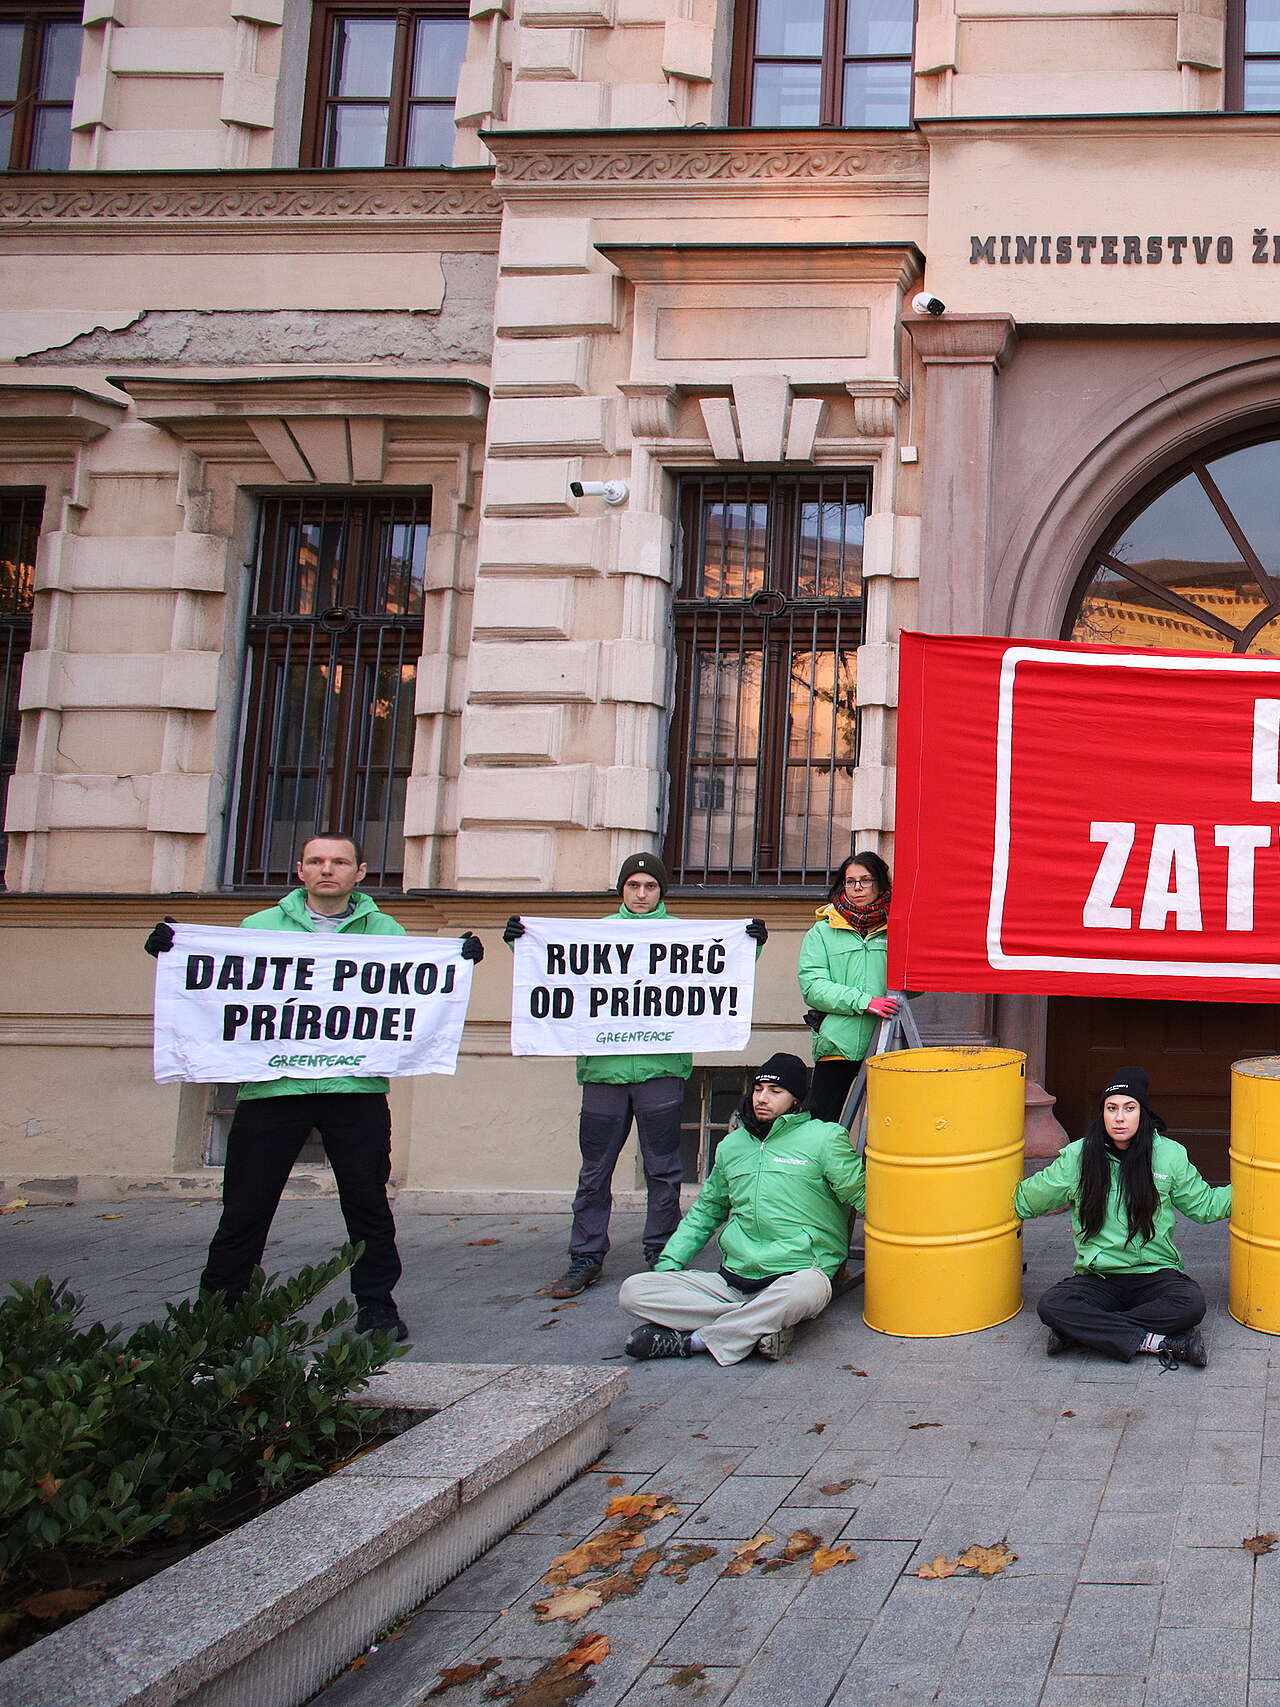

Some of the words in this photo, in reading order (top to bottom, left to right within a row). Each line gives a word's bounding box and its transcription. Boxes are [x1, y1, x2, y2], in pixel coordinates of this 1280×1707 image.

[969, 235, 1233, 265] MINISTERSTVO
[185, 954, 316, 992] DAJTE
[332, 959, 456, 996] POKOJ
[546, 943, 635, 976] RUKY
[648, 937, 726, 975] PREČ
[530, 986, 575, 1019] OD
[589, 978, 738, 1018] PRÍRODY!
[222, 997, 414, 1042] PRÍRODE!
[595, 1029, 676, 1045] GREENPEACE
[267, 1053, 367, 1069] GREENPEACE
